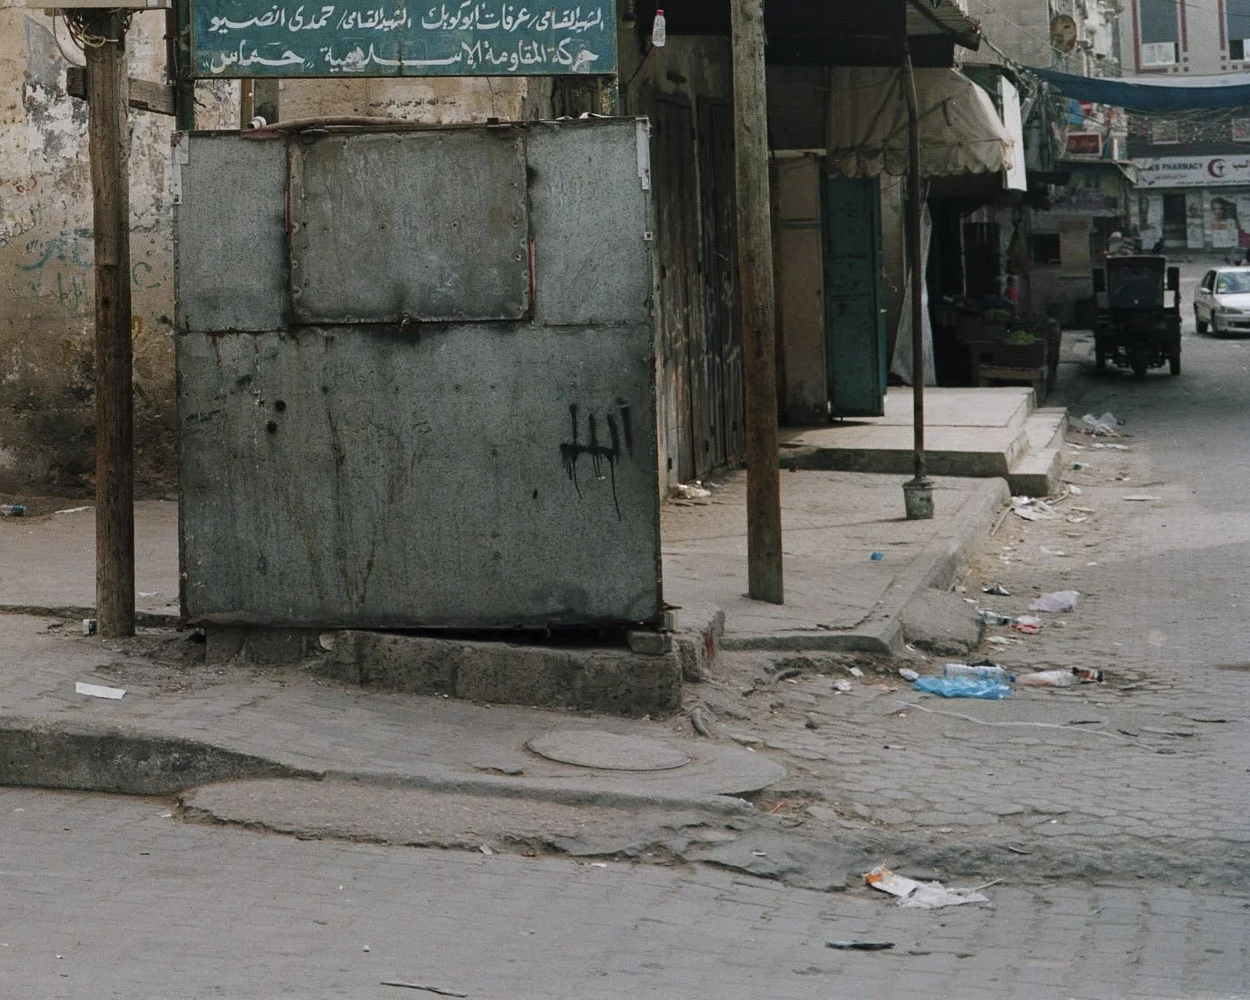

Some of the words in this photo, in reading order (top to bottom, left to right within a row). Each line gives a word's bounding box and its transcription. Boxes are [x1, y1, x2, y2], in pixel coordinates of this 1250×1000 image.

[484, 39, 546, 72] المقاومة
[547, 36, 600, 72] حركة
[1161, 162, 1203, 170] PHARMACY
